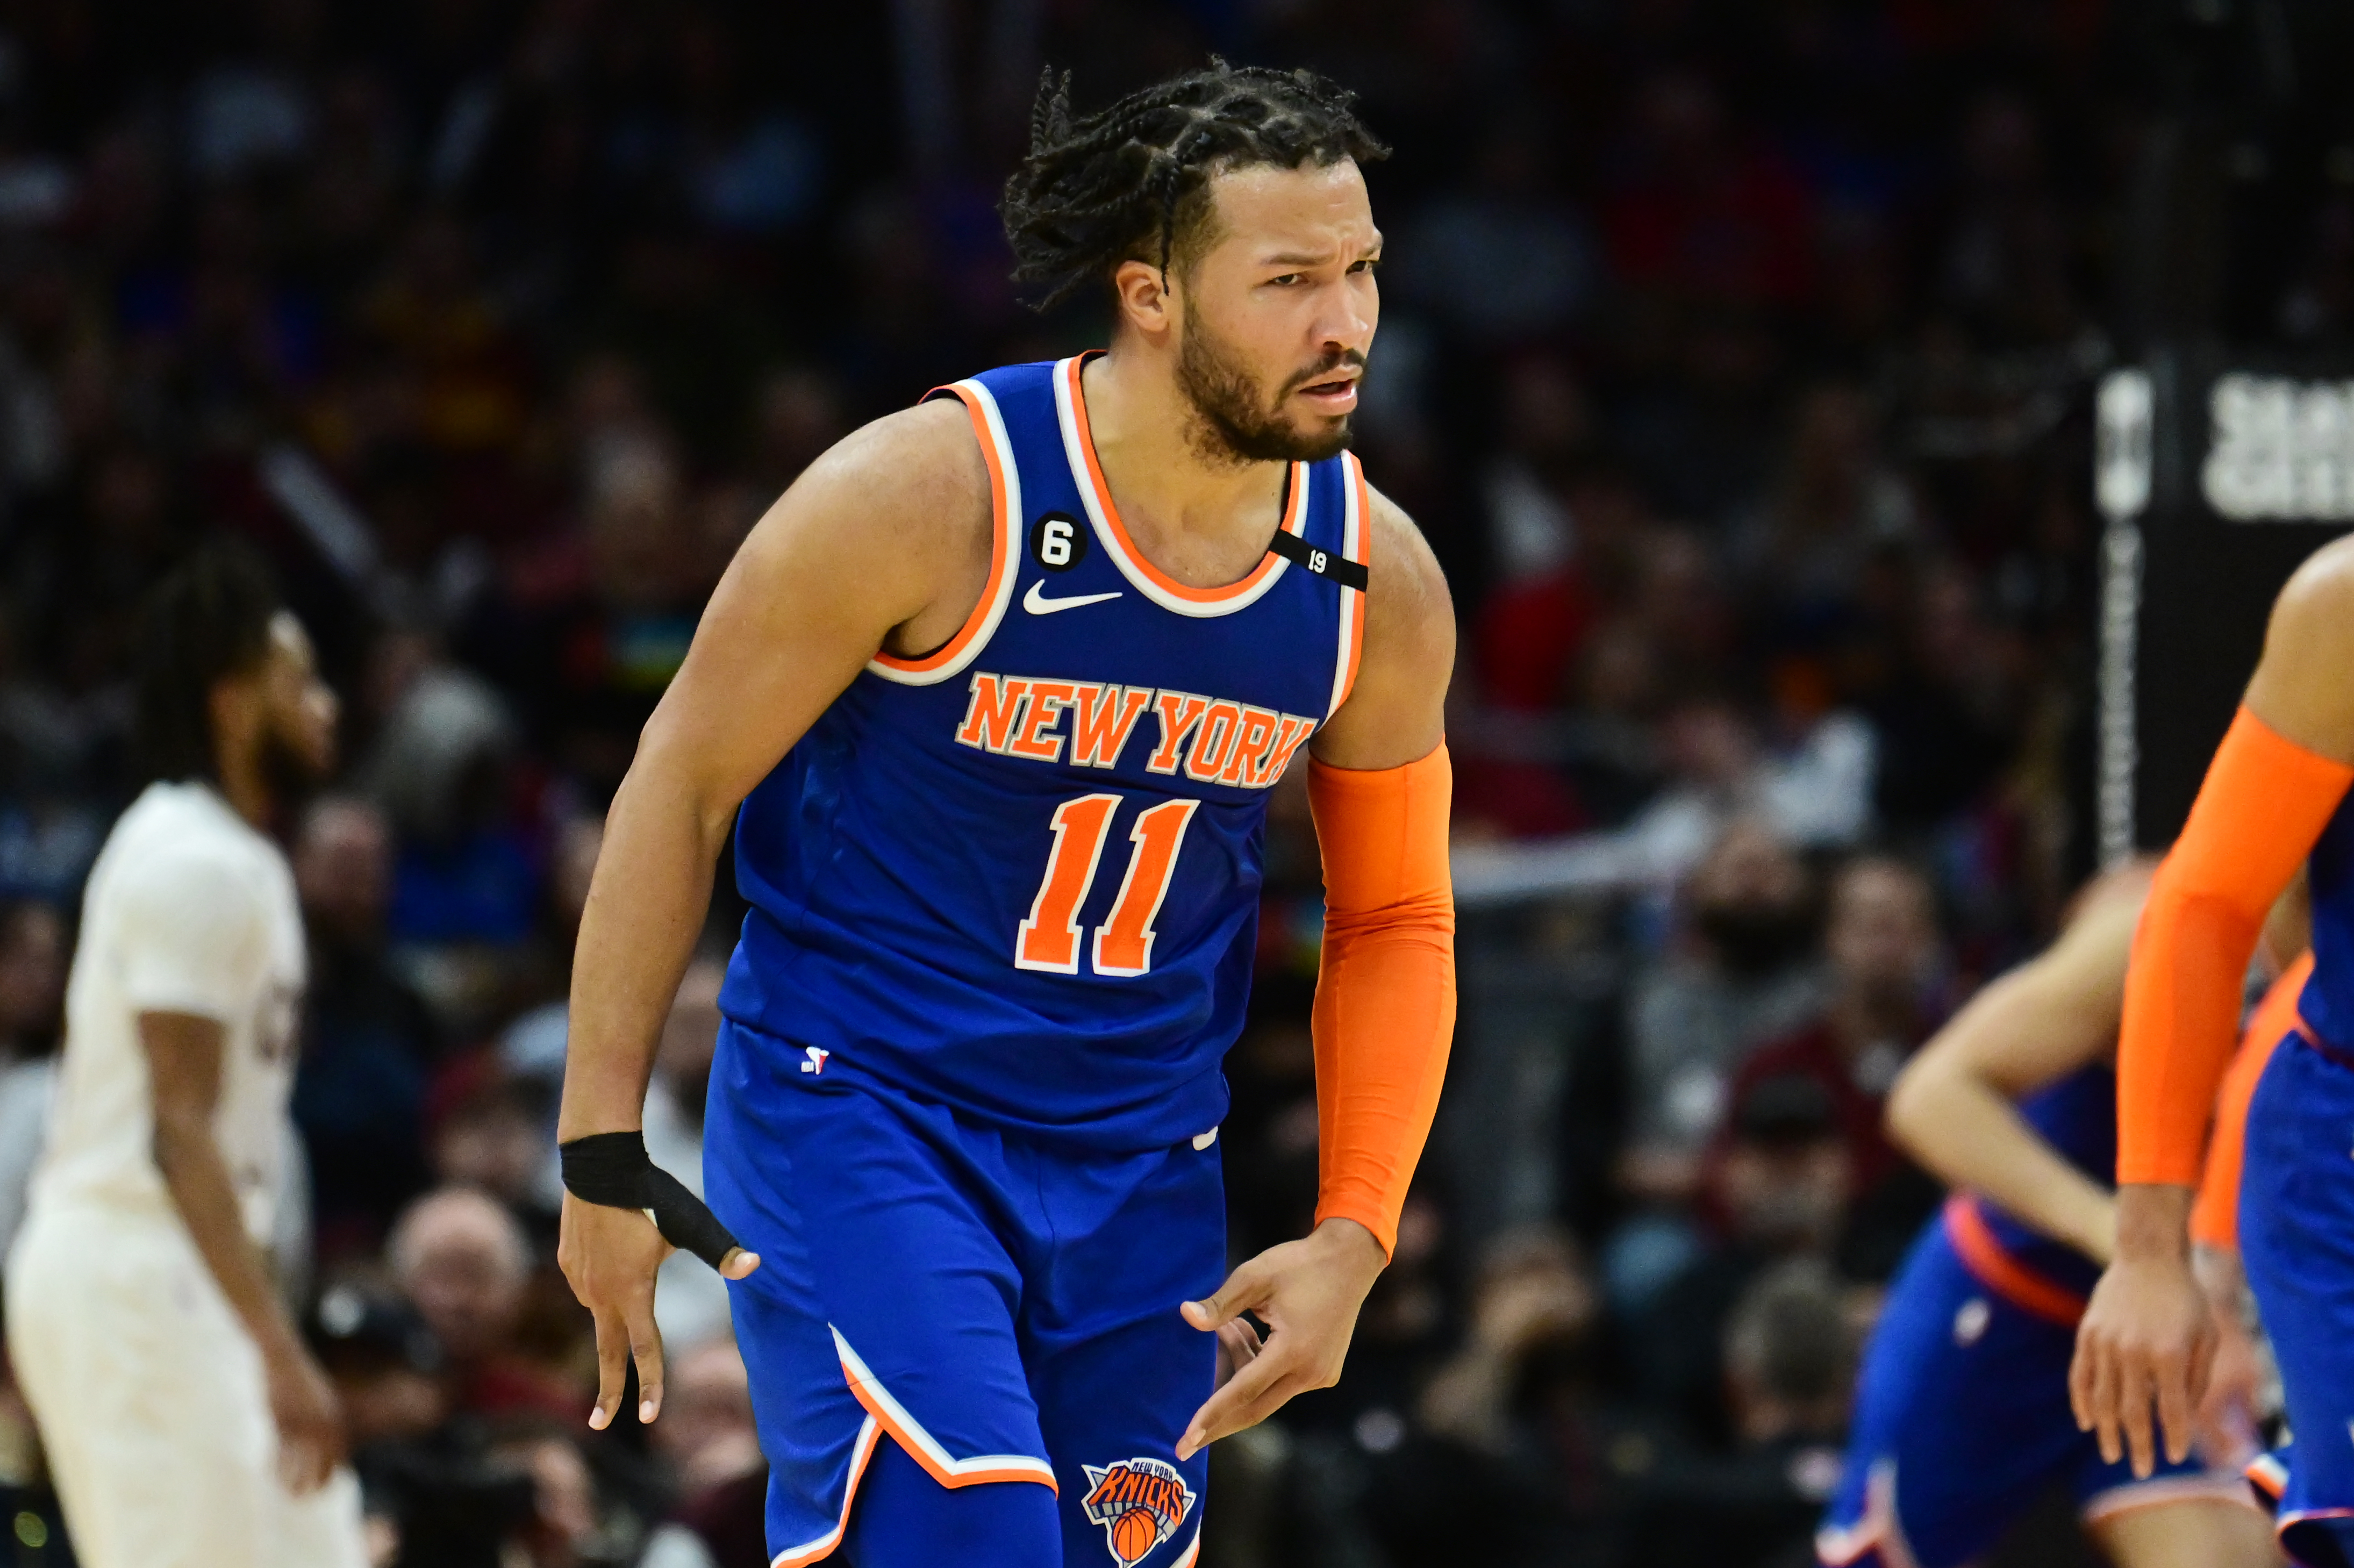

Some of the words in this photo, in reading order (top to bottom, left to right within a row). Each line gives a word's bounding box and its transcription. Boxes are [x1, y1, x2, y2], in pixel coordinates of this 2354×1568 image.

[1041, 520, 1074, 565] 6
[1308, 549, 1327, 574] 19
[955, 670, 1155, 769] NEW
[1145, 689, 1319, 789] YORK
[1014, 793, 1201, 977] 11
[1088, 1468, 1184, 1527] KNICKS
[1132, 1462, 1153, 1473] NEW
[1155, 1464, 1173, 1482] YORK
